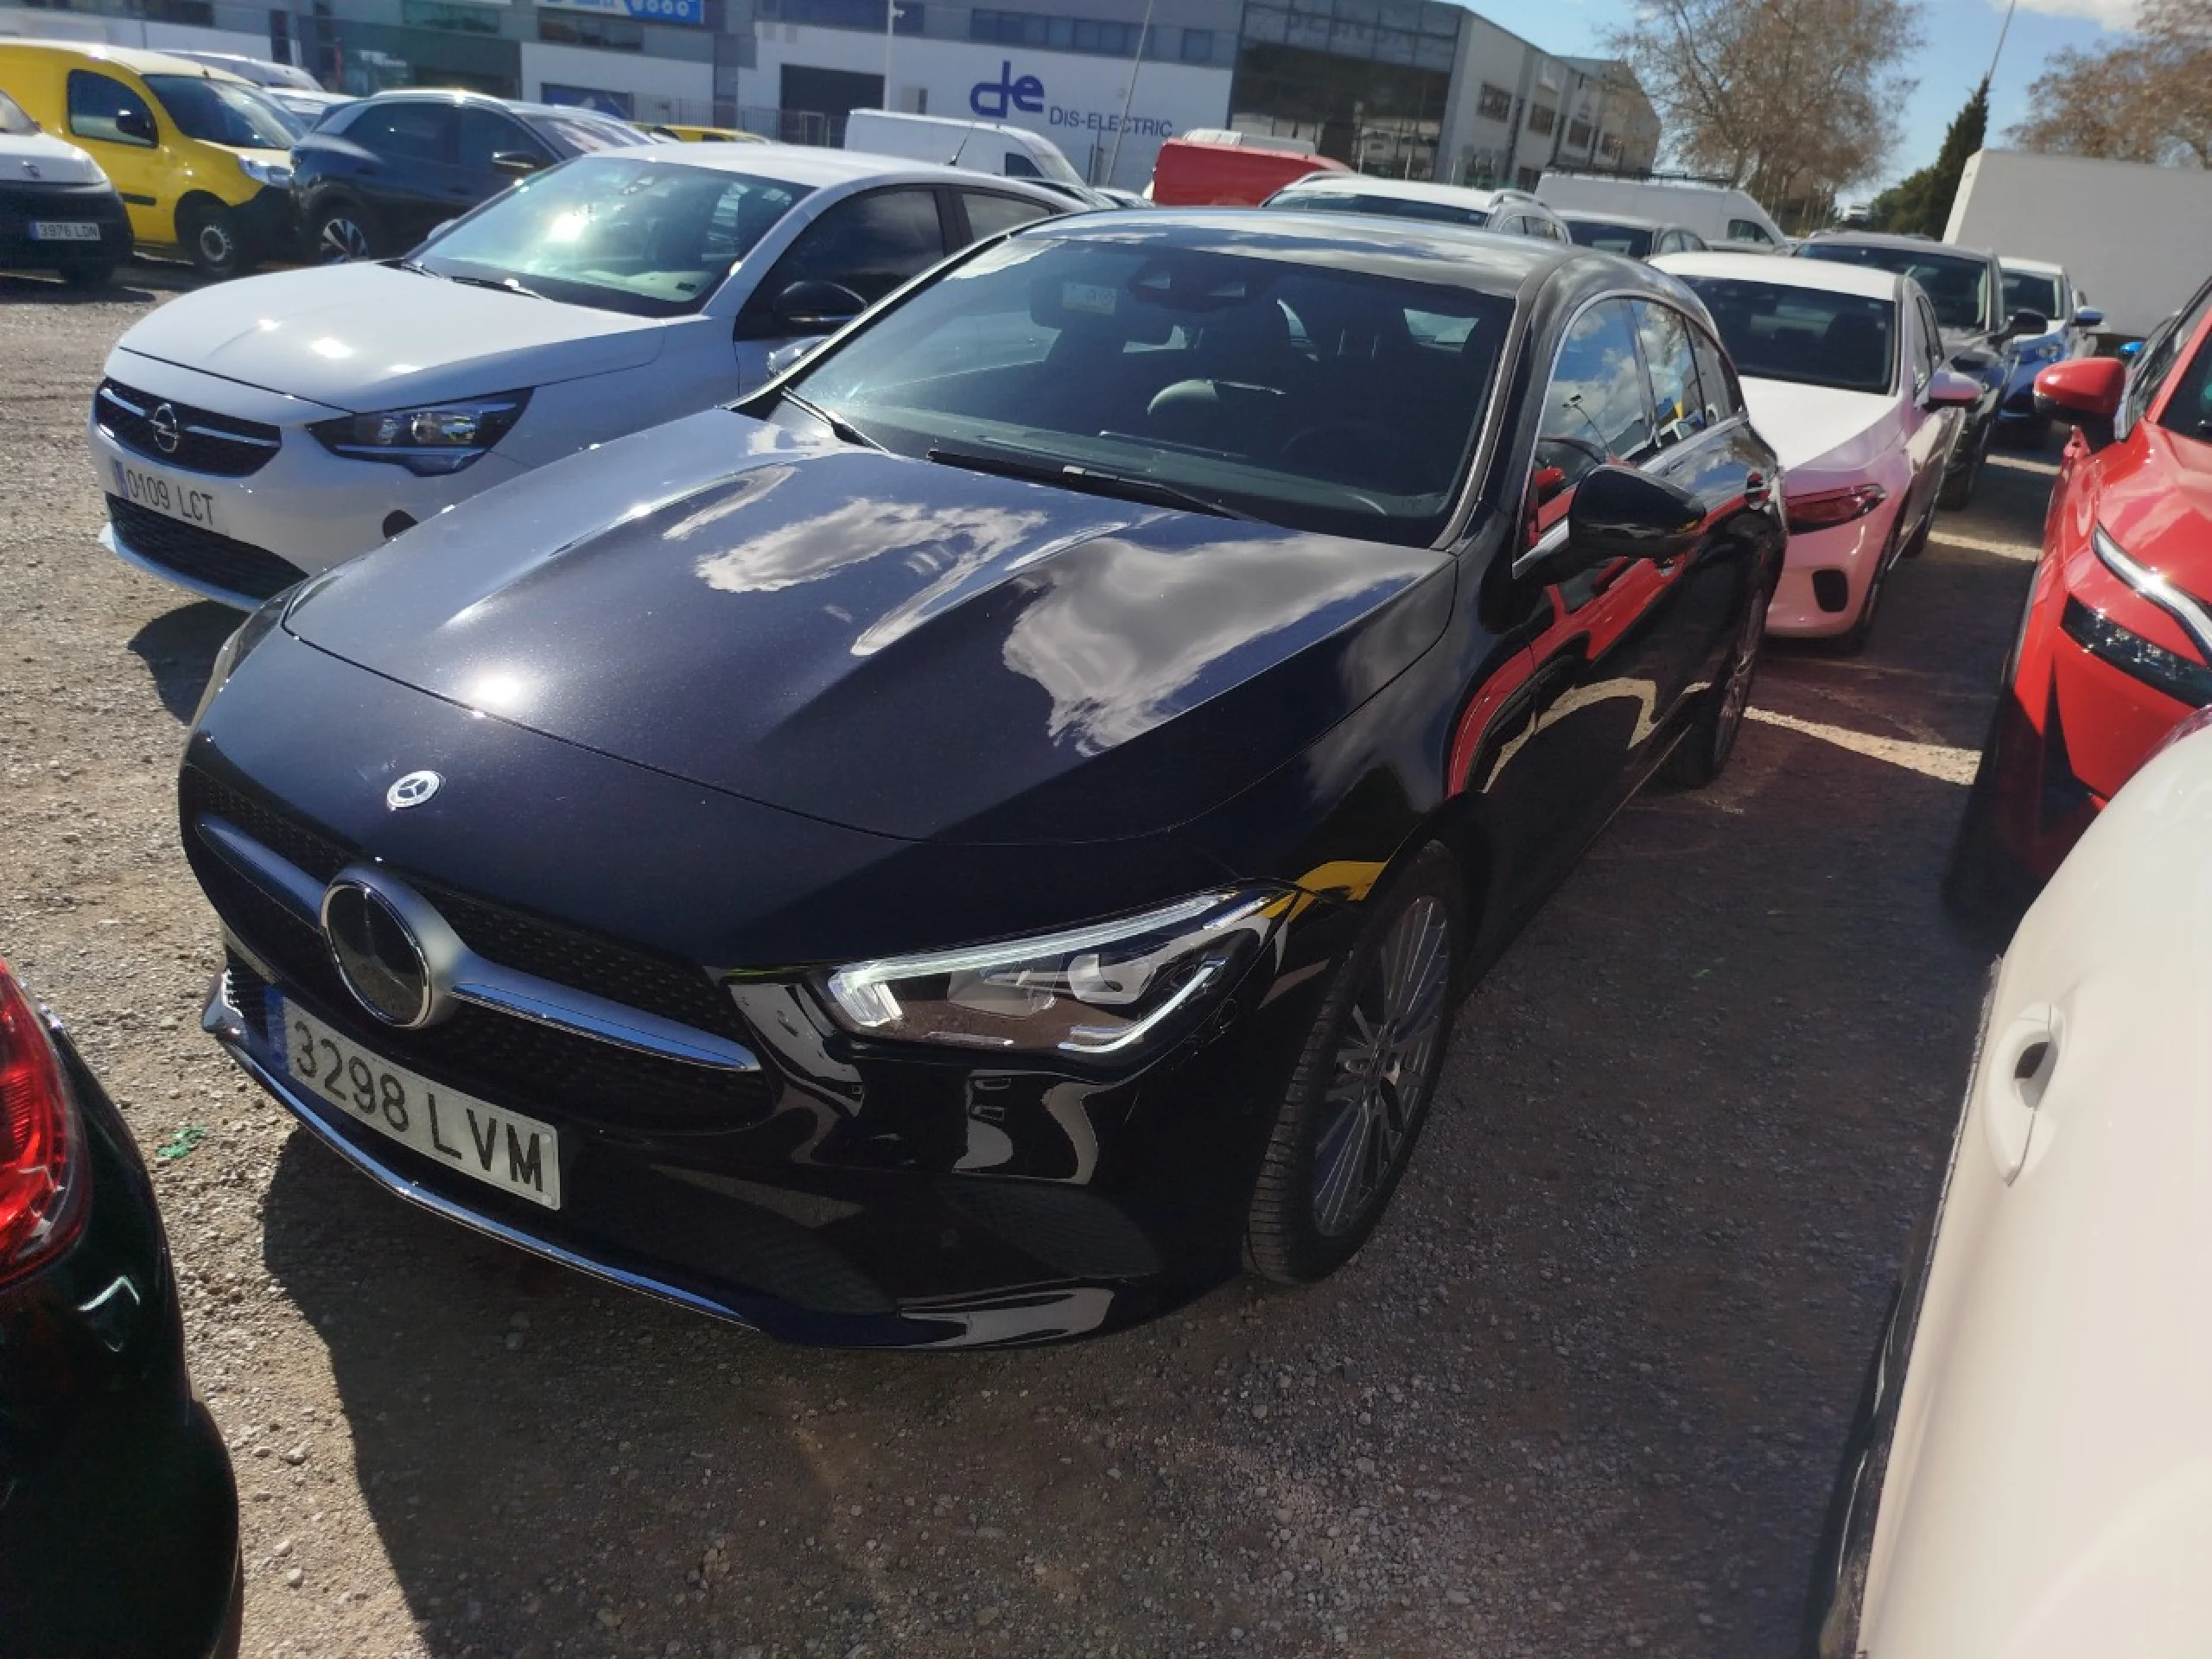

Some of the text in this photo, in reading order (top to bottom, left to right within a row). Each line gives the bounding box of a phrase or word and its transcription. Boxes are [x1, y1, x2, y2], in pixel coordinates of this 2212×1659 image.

[969, 60, 1044, 118] de
[1049, 105, 1173, 137] DIS-ELECTRIC
[39, 224, 98, 238] 3976 LDN
[125, 469, 213, 525] 0109 LCT
[294, 1020, 543, 1192] 3298 LVM
